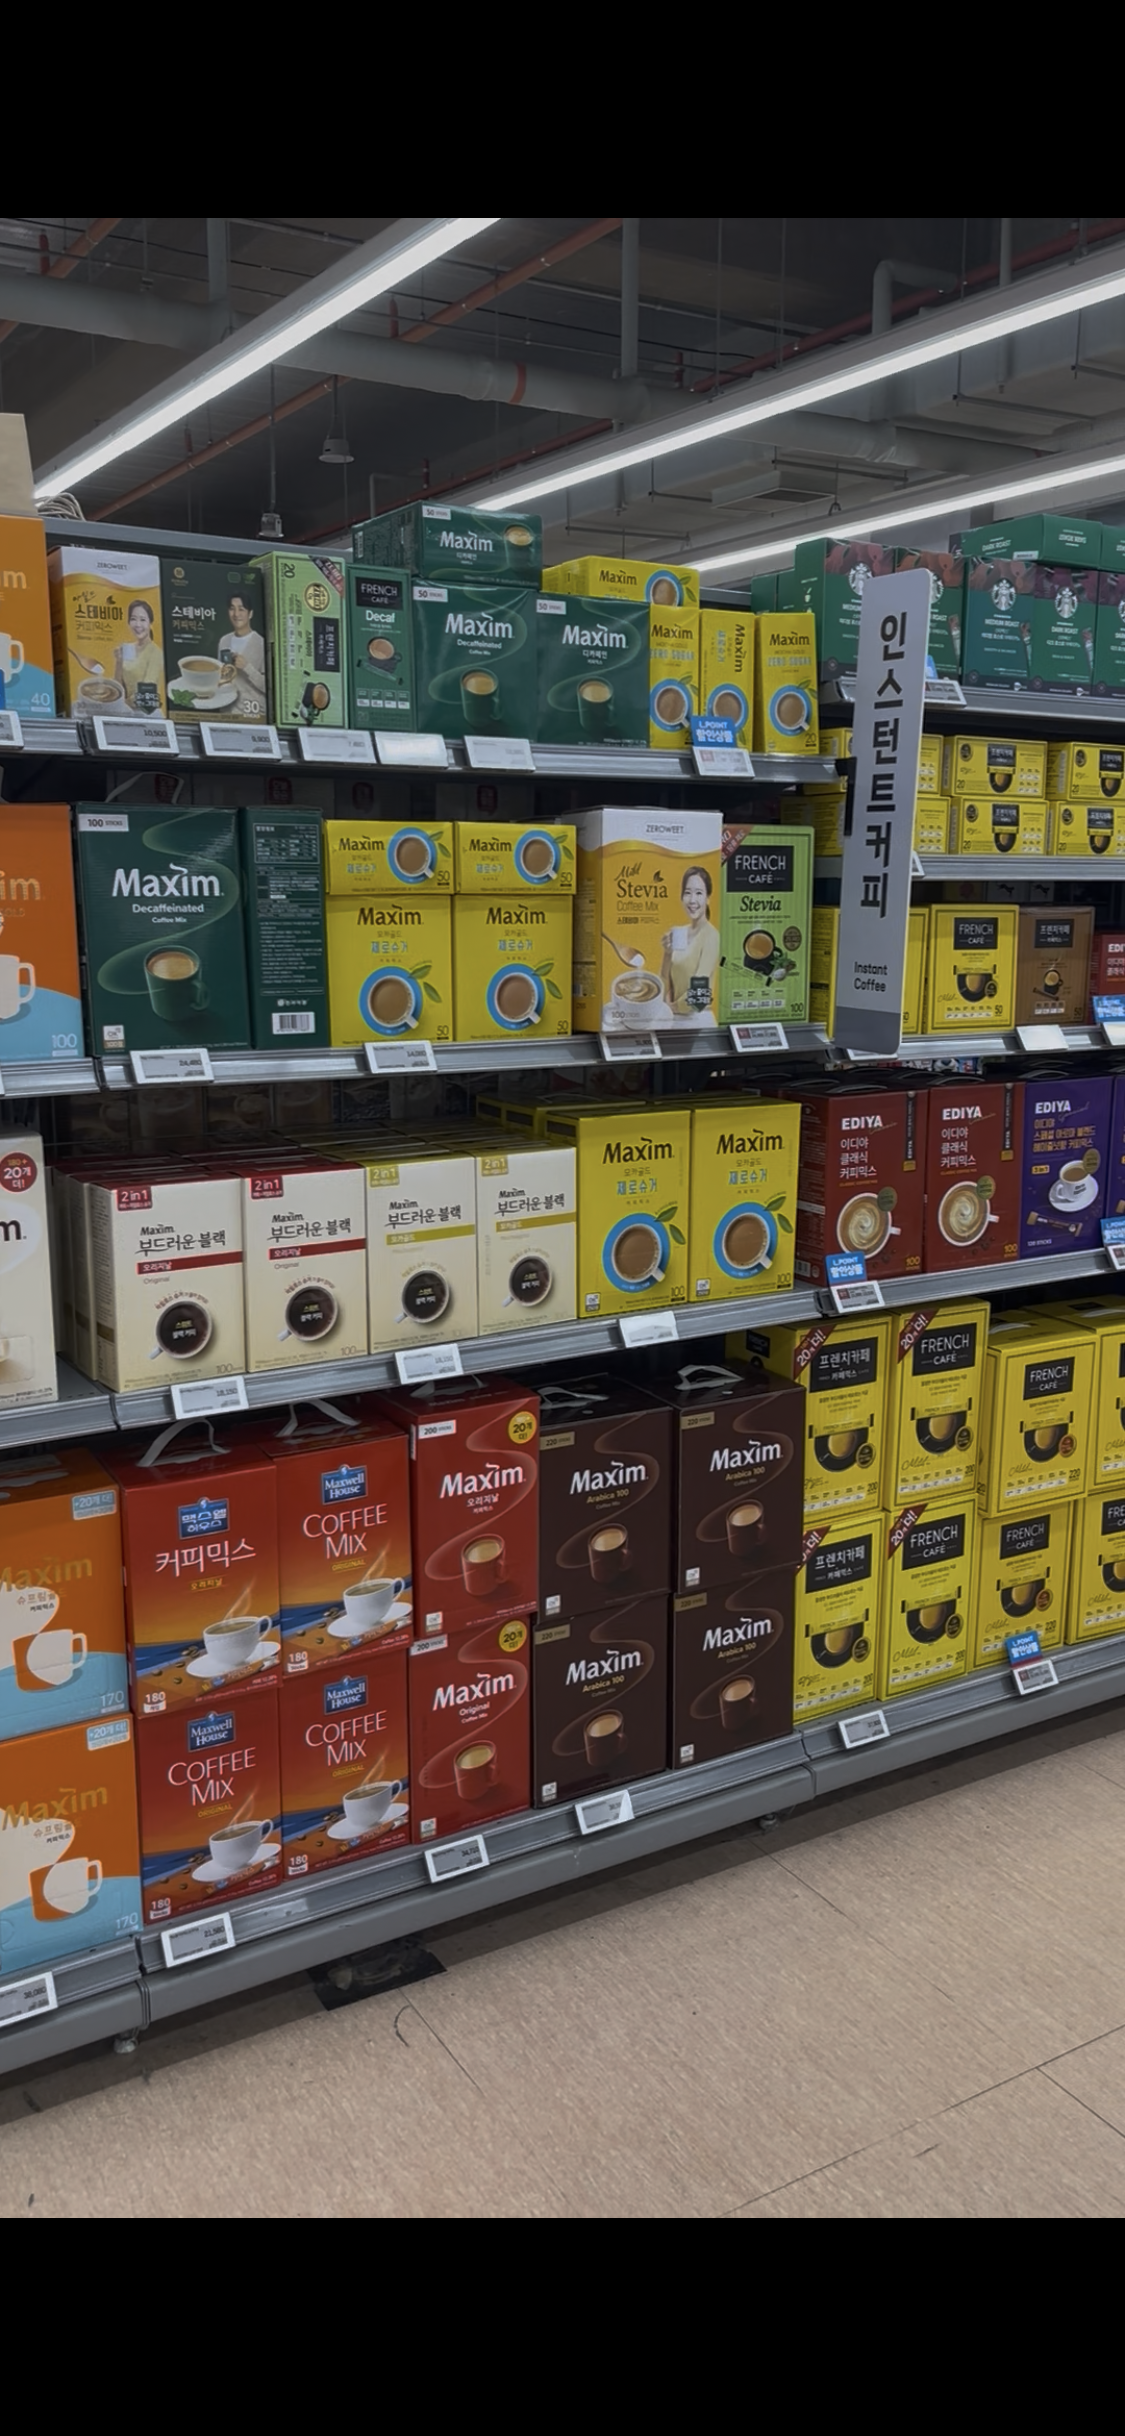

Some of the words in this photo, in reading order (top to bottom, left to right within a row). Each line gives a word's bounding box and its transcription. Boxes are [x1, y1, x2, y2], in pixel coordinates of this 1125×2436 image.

[440, 531, 494, 552] Maxim
[599, 570, 637, 586] Maxim
[361, 584, 398, 596] FRENCH
[418, 590, 428, 598] 50
[75, 604, 123, 621] 스테비아
[538, 602, 548, 610] 50
[172, 607, 216, 621] 스테비아
[366, 610, 395, 623] Decaf
[76, 620, 113, 632] 커피믹스
[172, 620, 205, 631] 커피믹스
[445, 612, 513, 639] Maxim
[651, 624, 693, 640] Maxim
[457, 638, 502, 650] Decaffeinated
[562, 624, 627, 649] Maxim
[770, 631, 810, 646] Maxim
[735, 624, 746, 673] Maxim
[31, 693, 50, 706] 40
[243, 701, 259, 713] 30
[805, 733, 816, 743] 20
[860, 612, 908, 919] 인스턴트커피
[87, 818, 104, 828] 100
[646, 825, 684, 833] ZEROWEET
[338, 835, 385, 850] Maxim
[469, 837, 512, 852] Maxim
[735, 855, 786, 870] FRENCH
[112, 863, 221, 896] Maxim
[437, 871, 450, 882] 50
[560, 872, 572, 883] 50
[748, 872, 773, 884] CAFÉ
[616, 879, 668, 898] Stevia
[132, 903, 204, 914] Decaffeinated
[616, 901, 643, 912] Coffee
[645, 902, 659, 911] Mix
[740, 896, 781, 913] Stevia
[357, 904, 421, 925] Maxim
[486, 904, 546, 925] Maxim
[959, 924, 994, 935] FRENCH
[371, 941, 407, 954] 제로슈거
[498, 940, 532, 952] 제로슈거
[854, 962, 888, 976] Instant
[854, 978, 886, 992] Coffee
[790, 1004, 804, 1013] 100
[437, 1026, 449, 1036] 50
[557, 1021, 569, 1031] 50
[52, 1034, 77, 1048] 100
[942, 1105, 983, 1121] EDIYA
[1035, 1100, 1071, 1114] EDIYA
[842, 1115, 883, 1131] EDIYA
[942, 1127, 969, 1140] 이디야
[716, 1128, 783, 1155] Maxim
[840, 1137, 869, 1150] 이디야
[941, 1141, 968, 1154] 클래식
[603, 1137, 672, 1164] Maxim
[839, 1151, 869, 1165] 클래식
[940, 1155, 977, 1168] 커피믹스
[3, 1166, 32, 1179] 20개
[729, 1169, 768, 1185] 제로슈거
[839, 1165, 877, 1180] 커피믹스
[12, 1179, 25, 1189] 더!
[617, 1178, 657, 1195] 제로슈거
[499, 1188, 526, 1198] Maxim
[389, 1200, 419, 1210] Maxim
[494, 1199, 541, 1217] 부드러운
[544, 1194, 565, 1208] 블랙
[272, 1211, 304, 1223] Maxim
[384, 1210, 435, 1228] 부드러운
[439, 1205, 462, 1220] 블랙
[140, 1224, 175, 1236] Maxim
[267, 1221, 323, 1243] 부드러운
[327, 1218, 351, 1234] 블랙
[135, 1233, 194, 1256] 부드러운
[200, 1230, 226, 1247] 블랙
[777, 1274, 791, 1285] 100
[671, 1286, 686, 1298] 100
[914, 1314, 929, 1331] 더!
[810, 1329, 826, 1346] 더!
[921, 1333, 970, 1354] FRENCH
[818, 1347, 870, 1369] 프렌치카페
[933, 1350, 957, 1366] CAFÉ
[1030, 1365, 1069, 1383] FRENCH
[1039, 1379, 1057, 1392] CAFÉ
[424, 1426, 437, 1435] 200
[709, 1440, 781, 1471] Maxim
[440, 1462, 524, 1499] Maxim
[569, 1461, 646, 1495] Maxim
[725, 1469, 752, 1481] Arabica
[753, 1466, 765, 1475] 100
[325, 1474, 365, 1491] Maxwell
[329, 1486, 360, 1499] House
[467, 1493, 499, 1507] 오리지날
[586, 1490, 615, 1504] Arabica
[616, 1489, 629, 1498] 100
[182, 1509, 227, 1523] 맥스웰
[303, 1503, 388, 1538] COFFEE
[902, 1509, 918, 1527] 더!
[806, 1531, 823, 1548] 더!
[910, 1524, 958, 1548] FRENCH
[1006, 1523, 1045, 1543] FRENCH
[326, 1532, 367, 1559] MIX
[923, 1543, 946, 1558] CAFÉ
[1016, 1537, 1034, 1550] CAFÉ
[156, 1538, 256, 1577] 커피믹스
[815, 1545, 866, 1571] 프렌치카페
[703, 1617, 772, 1651] Maxim
[288, 1651, 308, 1662] 180
[717, 1645, 744, 1659] Arabica
[745, 1642, 757, 1651] 100
[566, 1650, 642, 1686] Maxim
[327, 1682, 366, 1701] Maxwell
[432, 1672, 514, 1711] Maxim
[582, 1678, 611, 1693] Arabica
[612, 1675, 625, 1684] 100
[100, 1691, 124, 1705] 170
[145, 1692, 166, 1703] 180
[331, 1695, 362, 1709] House
[459, 1702, 490, 1716] Original
[191, 1718, 232, 1738] Maxwell
[305, 1710, 387, 1747] COFFEE
[196, 1730, 229, 1747] House
[327, 1739, 366, 1767] MIX
[167, 1747, 256, 1787] COFFEE
[191, 1777, 235, 1806] MIX
[2, 1786, 109, 1831] Maxim
[290, 1854, 308, 1866] 180
[151, 1898, 171, 1910] 180
[115, 1913, 139, 1928] 170
